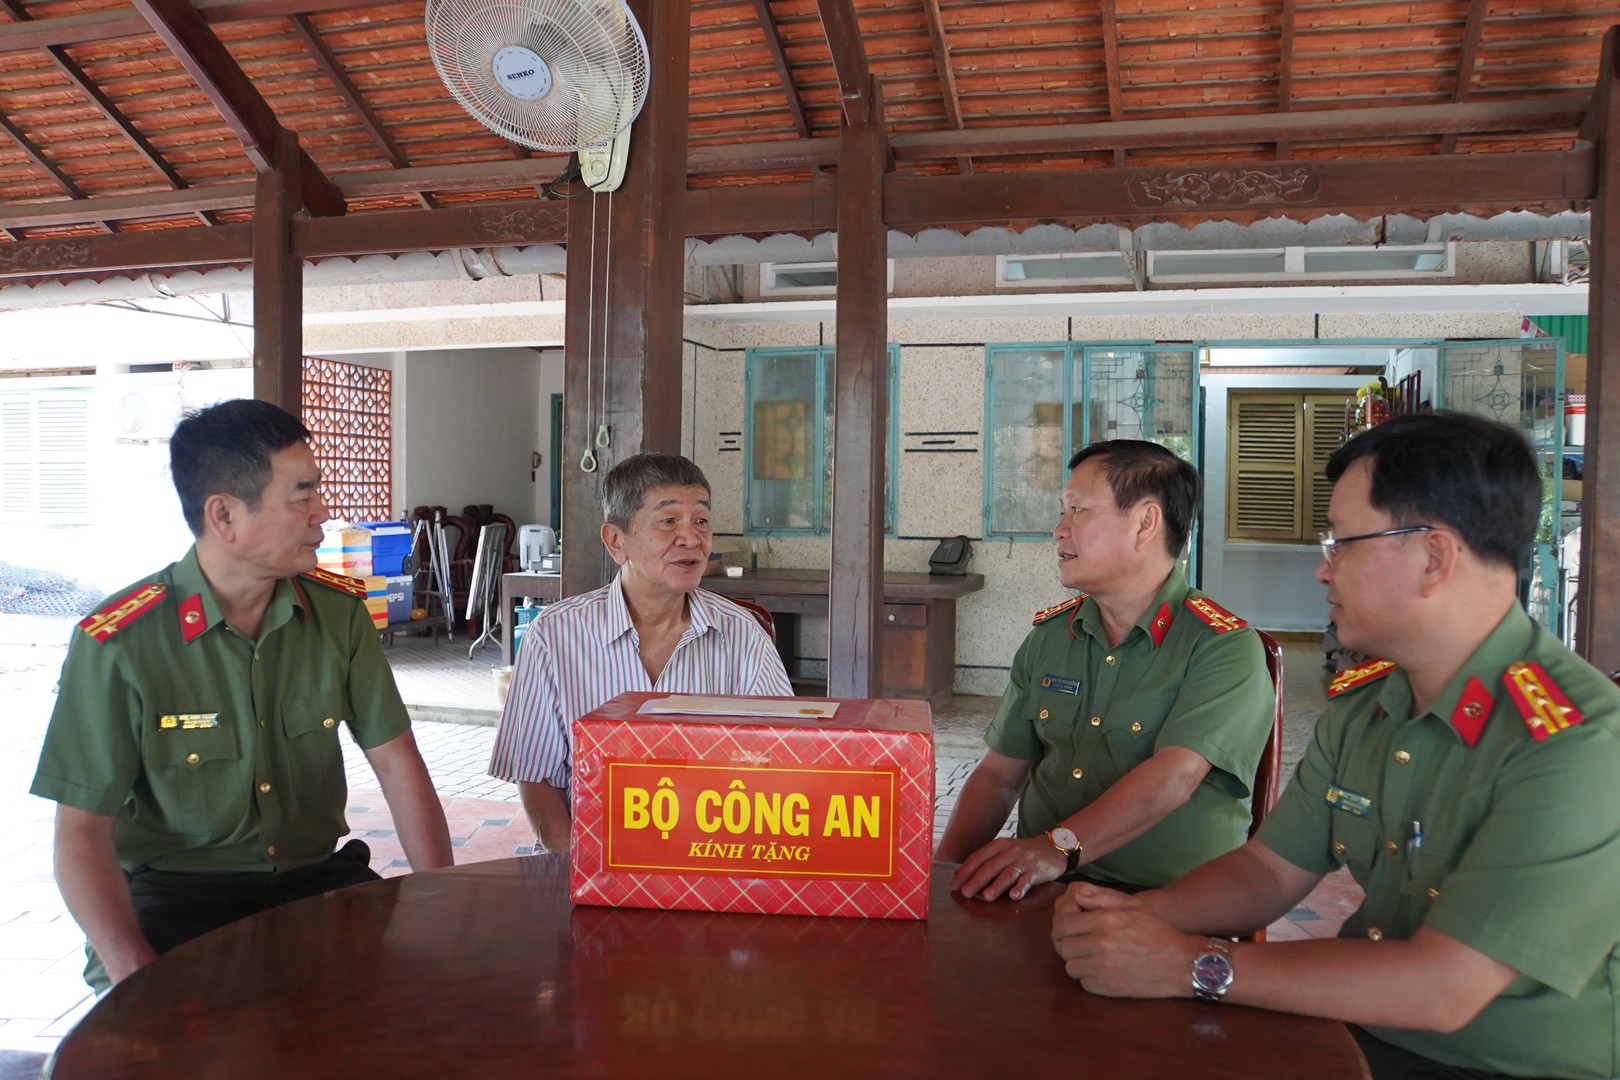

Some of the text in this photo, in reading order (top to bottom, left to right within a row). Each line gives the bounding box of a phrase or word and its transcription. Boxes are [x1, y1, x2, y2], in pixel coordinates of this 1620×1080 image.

[507, 69, 535, 80] SENKO
[387, 592, 405, 603] EPSI
[624, 777, 880, 840] BỘ CÔNG AN
[688, 839, 812, 863] KÍNH TẶNG
